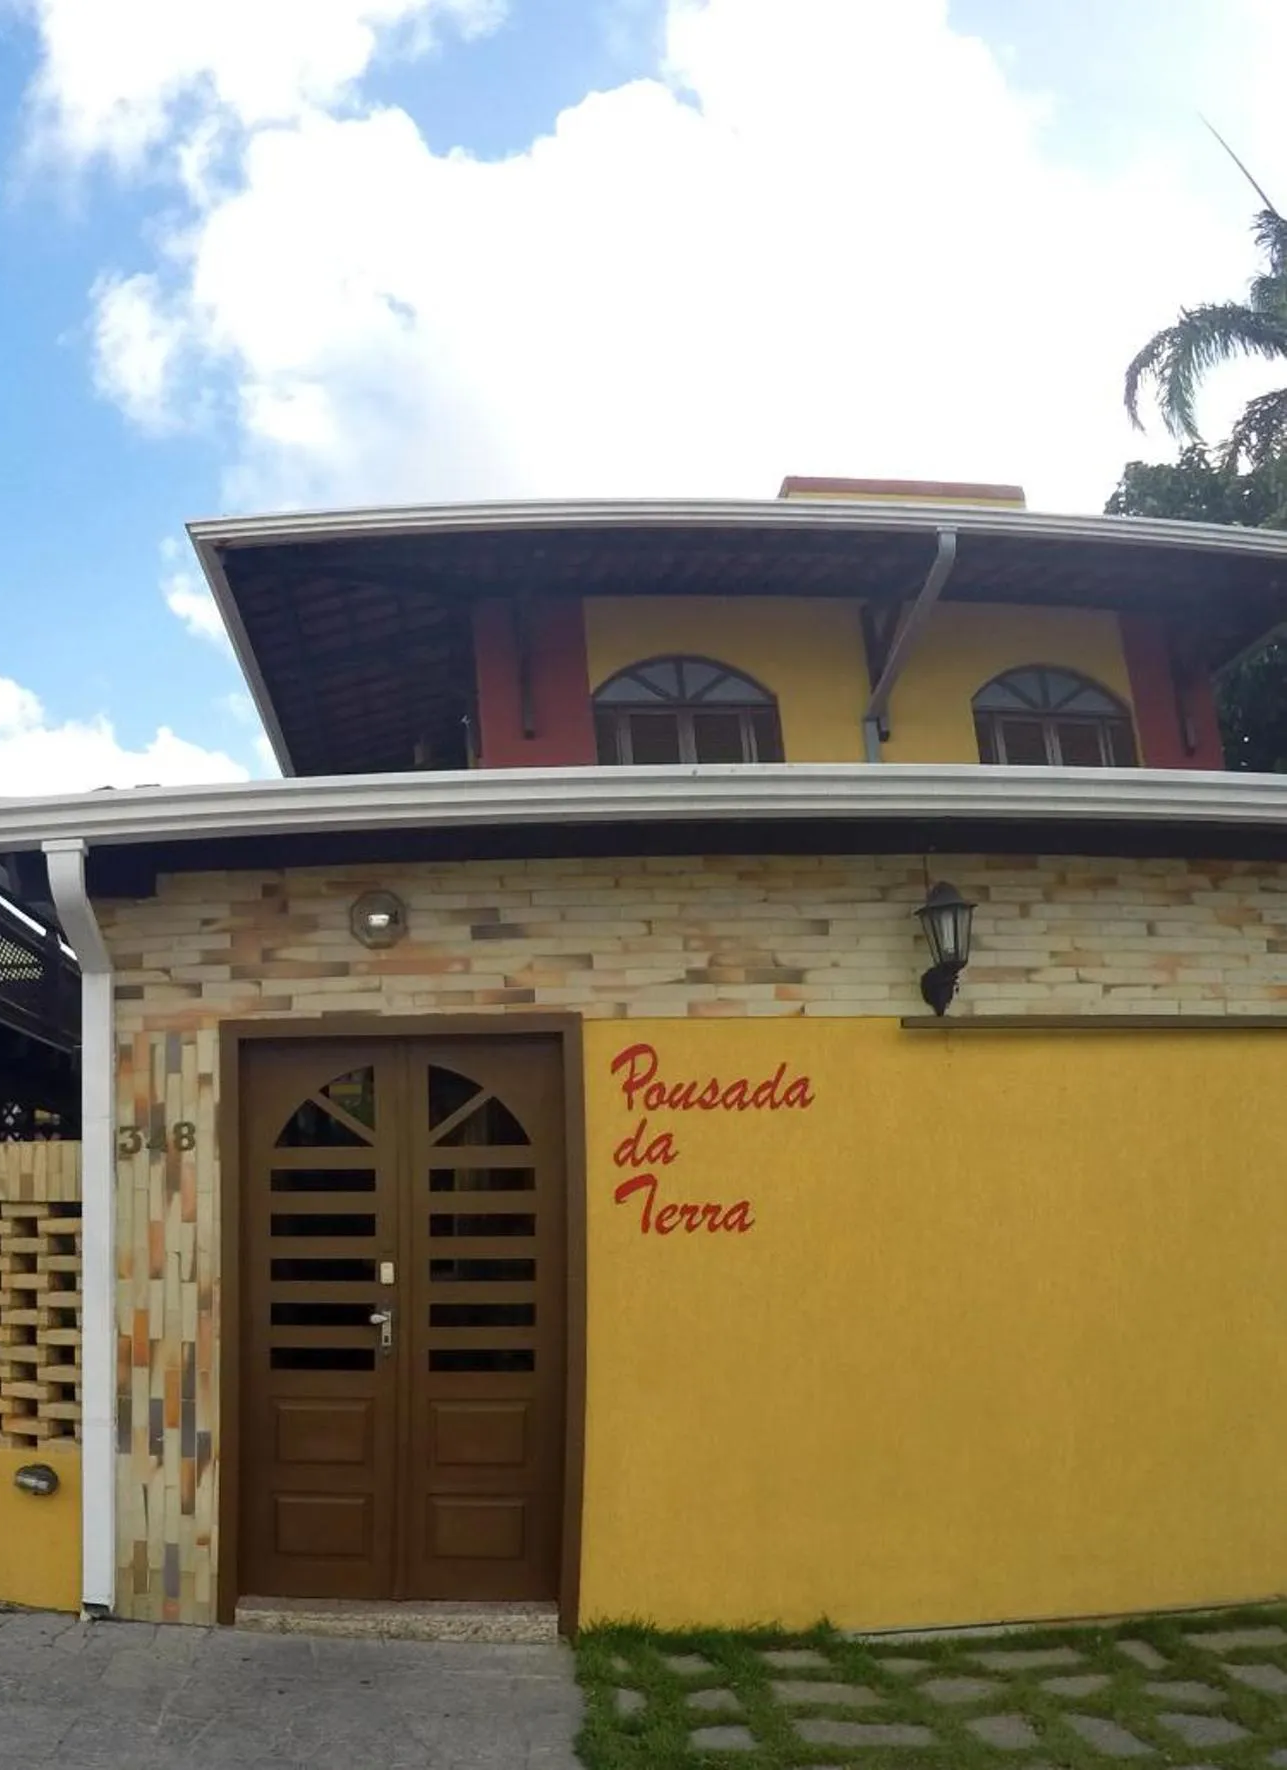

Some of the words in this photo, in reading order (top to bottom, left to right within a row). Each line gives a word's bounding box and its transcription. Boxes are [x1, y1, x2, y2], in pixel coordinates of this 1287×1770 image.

[611, 1043, 815, 1111] Pousada
[613, 1117, 679, 1168] da
[614, 1173, 755, 1235] Terra
